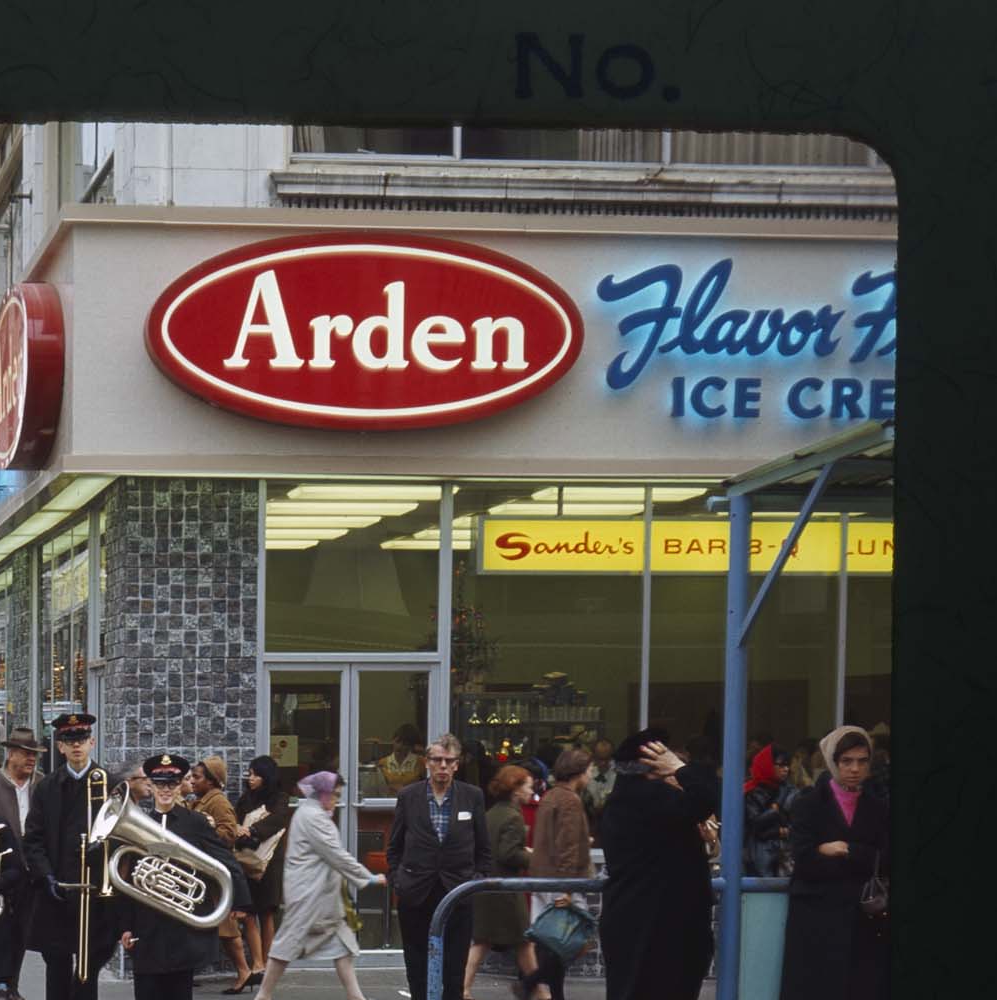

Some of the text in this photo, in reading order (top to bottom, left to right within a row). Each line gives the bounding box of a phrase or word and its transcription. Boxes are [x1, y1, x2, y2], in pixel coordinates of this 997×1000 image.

[514, 31, 681, 102] No.
[222, 269, 530, 371] Arden
[596, 257, 845, 390] Flavor
[670, 376, 762, 418] ICE
[495, 531, 635, 561] Sander's
